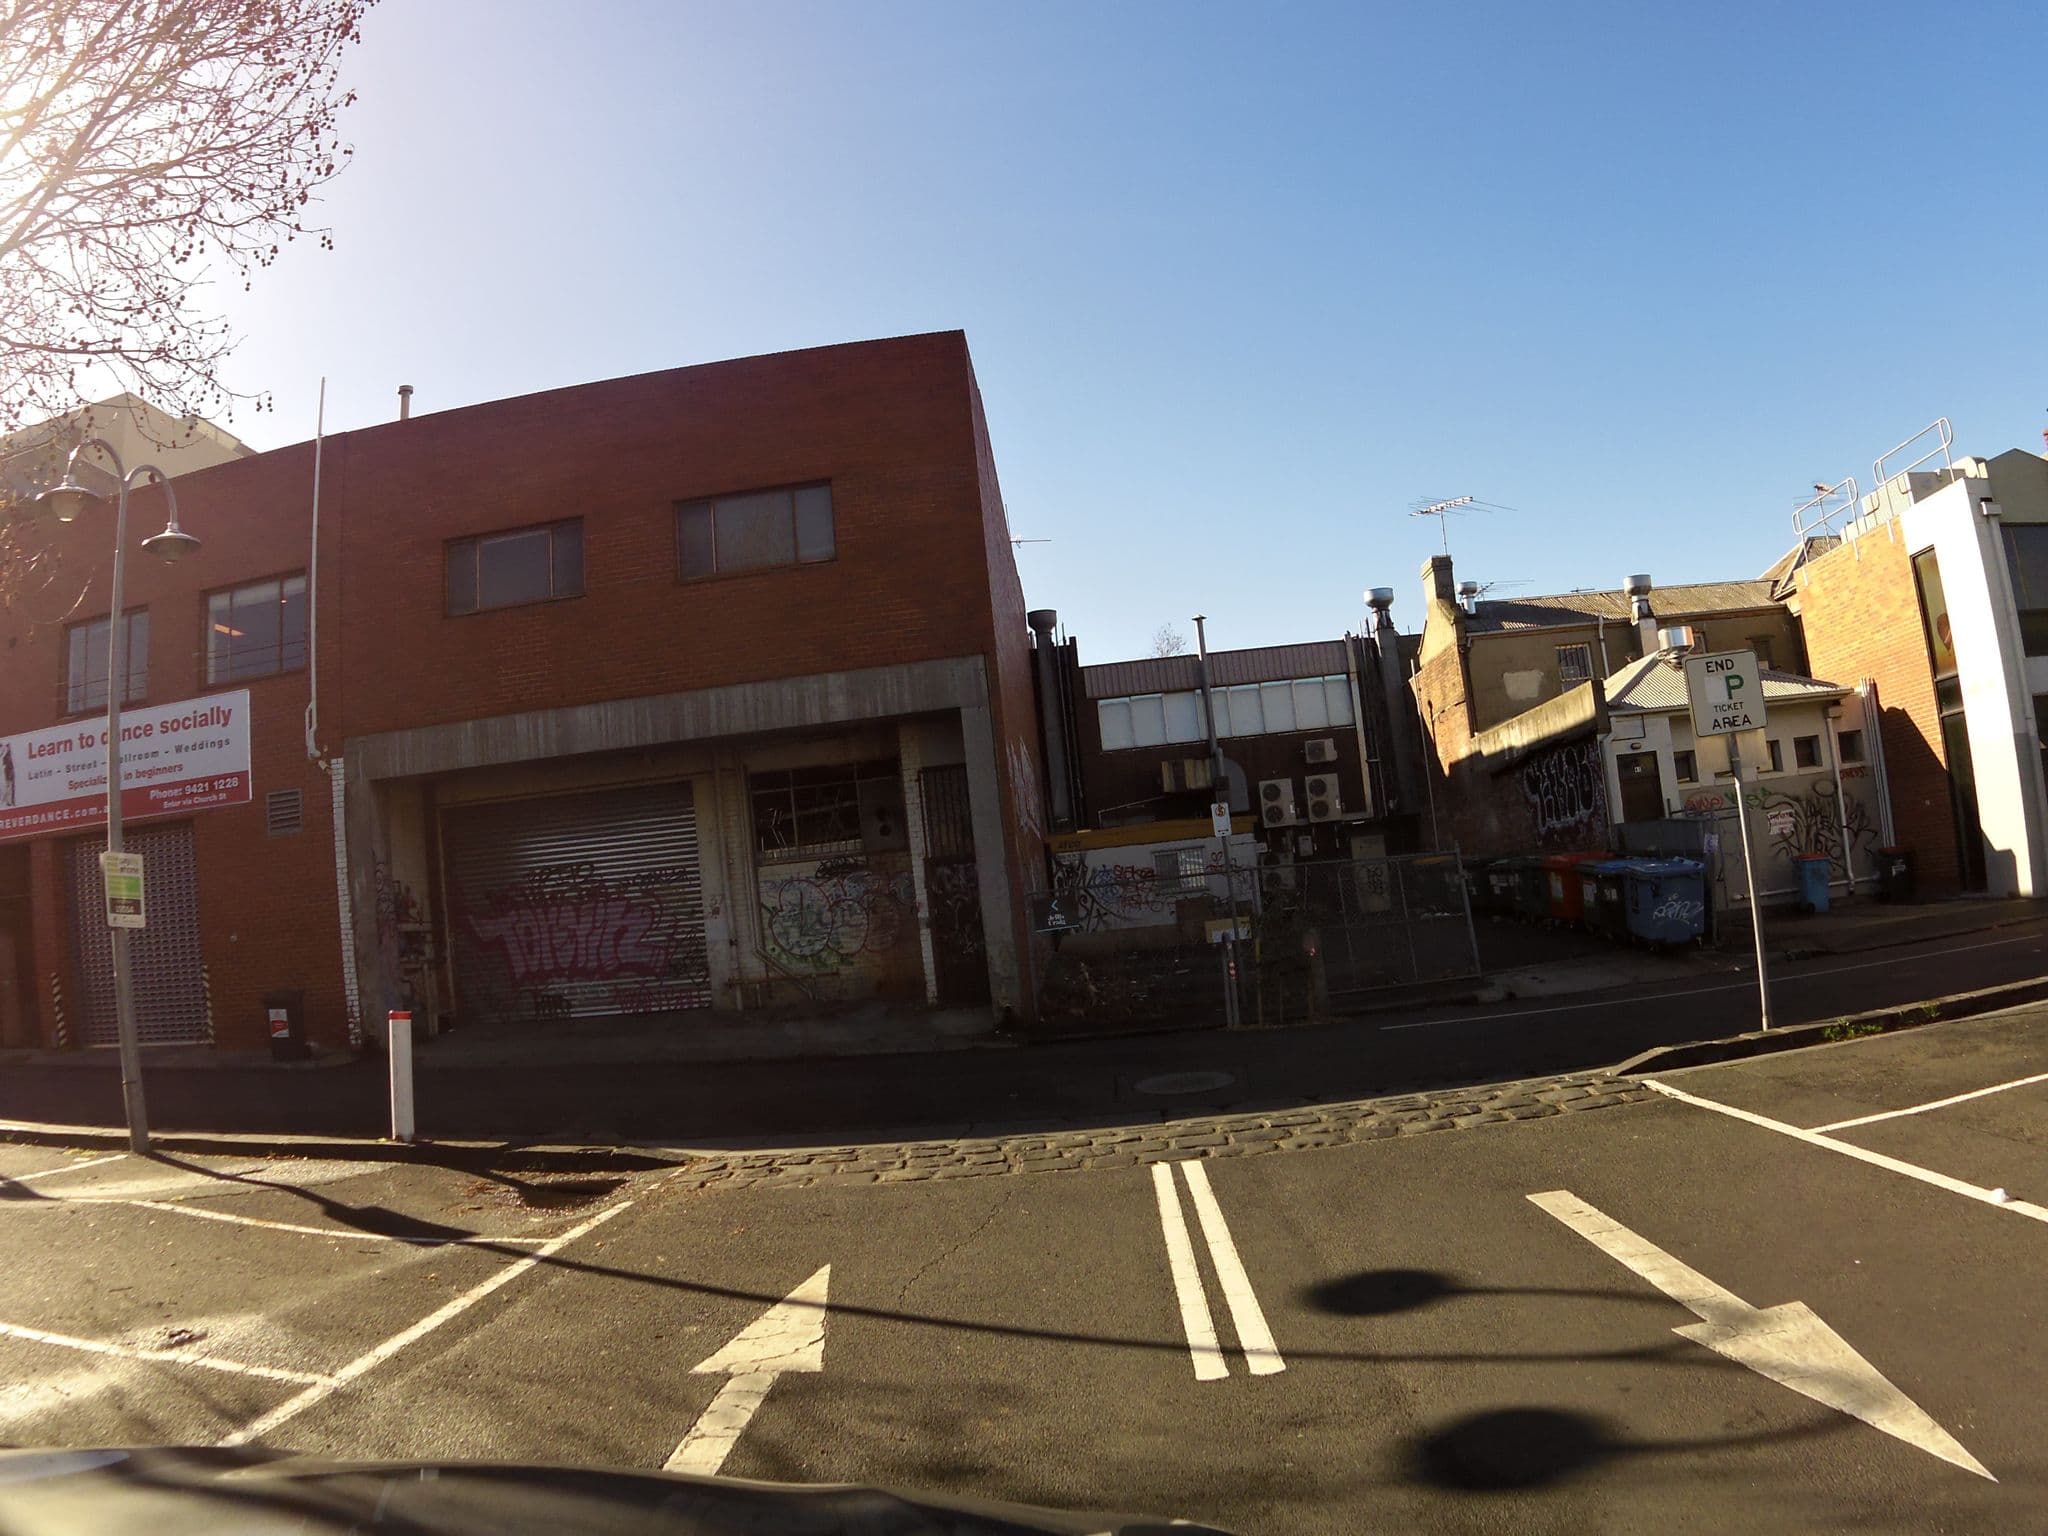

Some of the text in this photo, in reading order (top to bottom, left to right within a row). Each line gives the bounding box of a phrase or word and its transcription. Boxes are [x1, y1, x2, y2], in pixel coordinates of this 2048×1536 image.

[1705, 659, 1735, 673] END
[1725, 674, 1745, 700] P
[1713, 702, 1745, 712] TICKET
[1712, 714, 1752, 731] AREA
[28, 706, 233, 760] Learn to dnce socially
[28, 769, 52, 780] Latin
[66, 760, 97, 774] Street
[175, 738, 231, 755] Weddings
[124, 771, 133, 780] in
[135, 764, 184, 779] beginners
[185, 782, 209, 795] 9421
